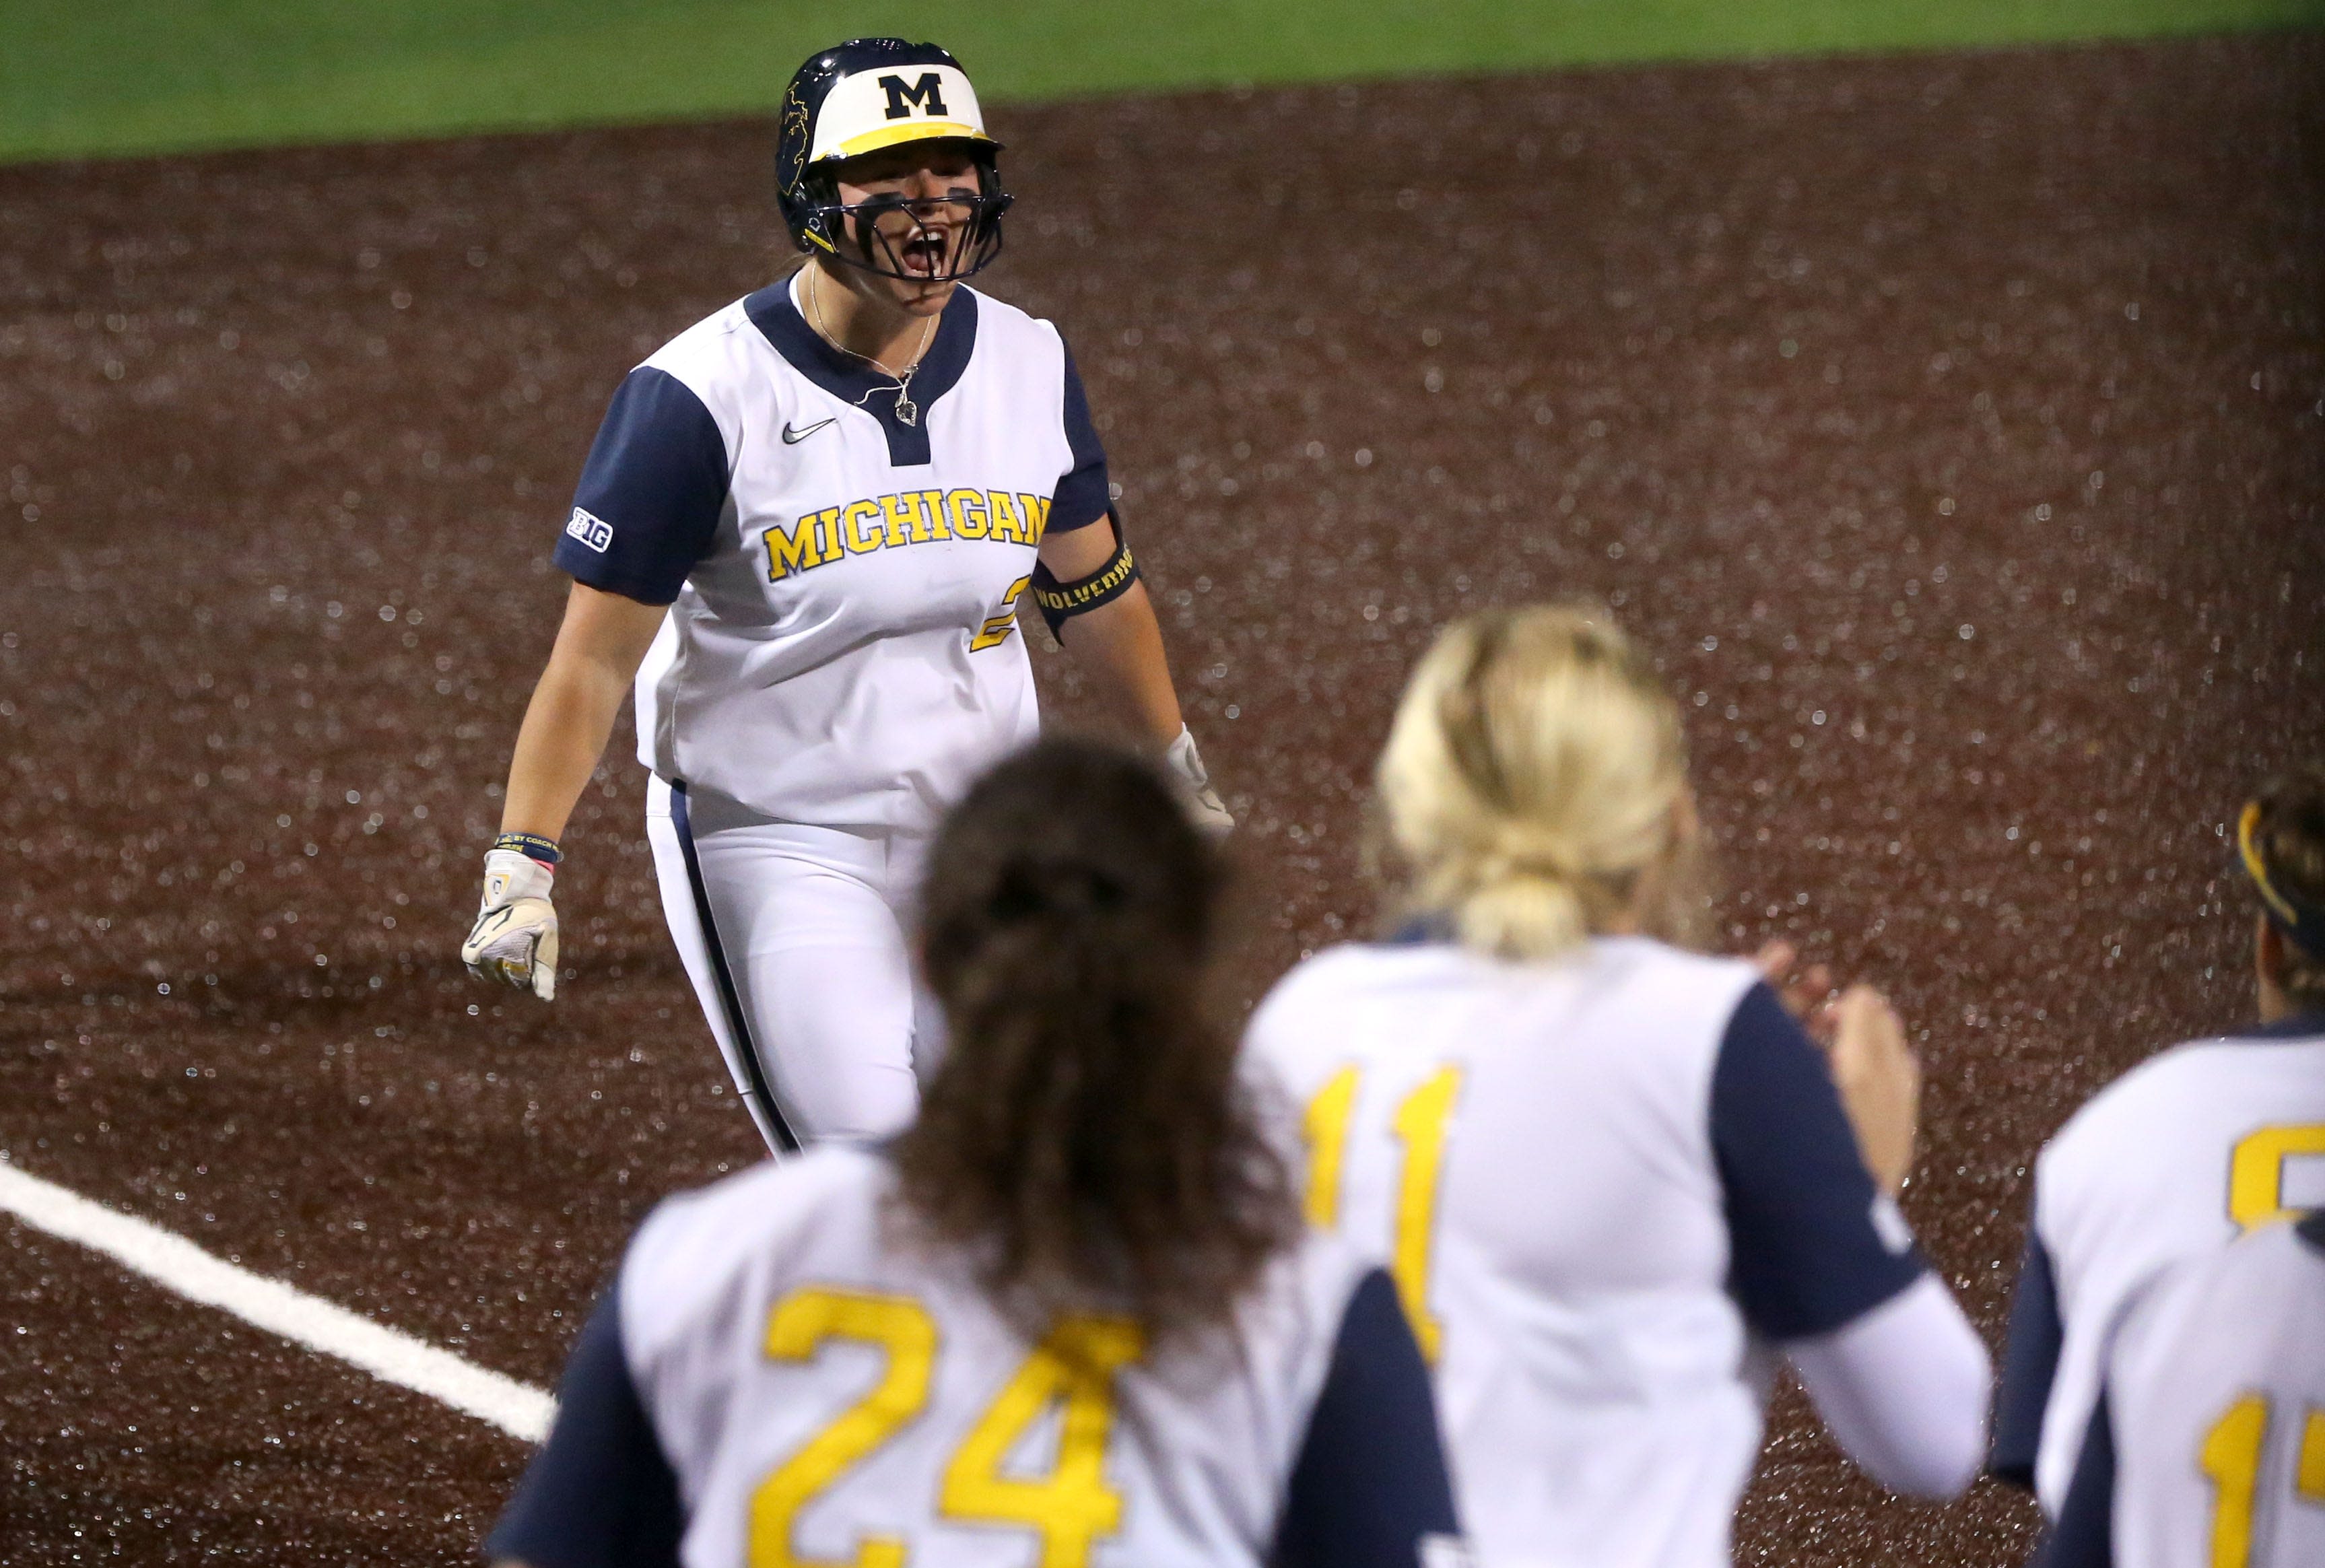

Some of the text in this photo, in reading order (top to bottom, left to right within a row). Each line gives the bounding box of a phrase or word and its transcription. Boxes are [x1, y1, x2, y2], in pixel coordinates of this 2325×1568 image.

[877, 72, 949, 121] M
[762, 487, 1053, 583] MICHIGAN
[1298, 1061, 1467, 1365] 11
[746, 1289, 1146, 1568] 24
